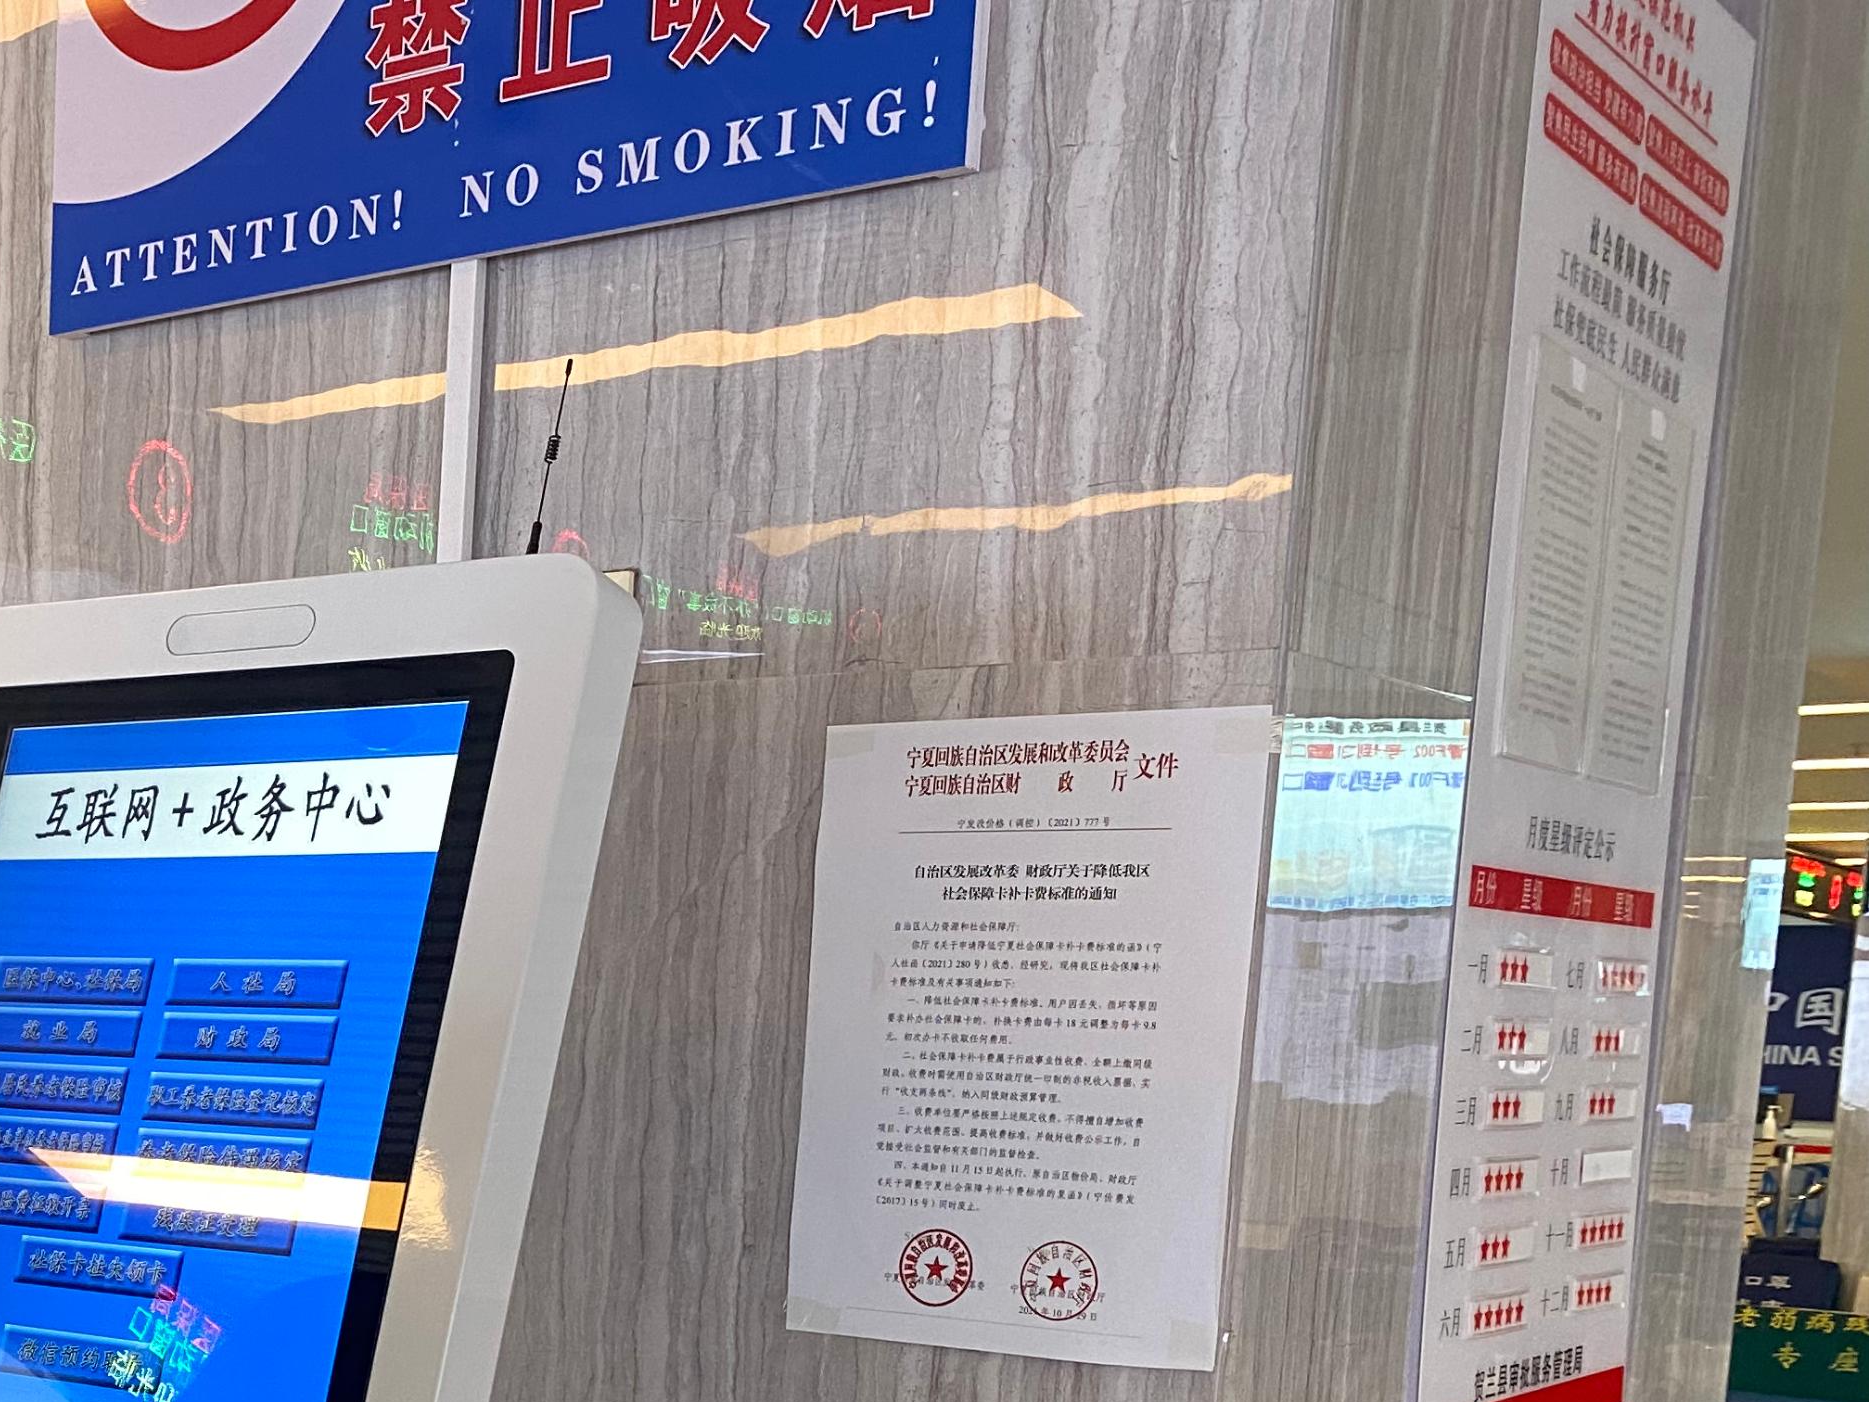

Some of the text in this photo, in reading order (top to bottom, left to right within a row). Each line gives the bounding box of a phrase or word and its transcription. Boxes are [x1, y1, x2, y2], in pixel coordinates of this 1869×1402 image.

[70, 79, 938, 296] ATTENTION! NO SMOKING!
[907, 738, 1179, 780] 宁夏回族自治区发展和改革委员会 文件
[914, 862, 1151, 879] 自治区发展改革委 财政厅关于降低我区
[942, 885, 1118, 901] 社会保障卡补卡费标准的通知
